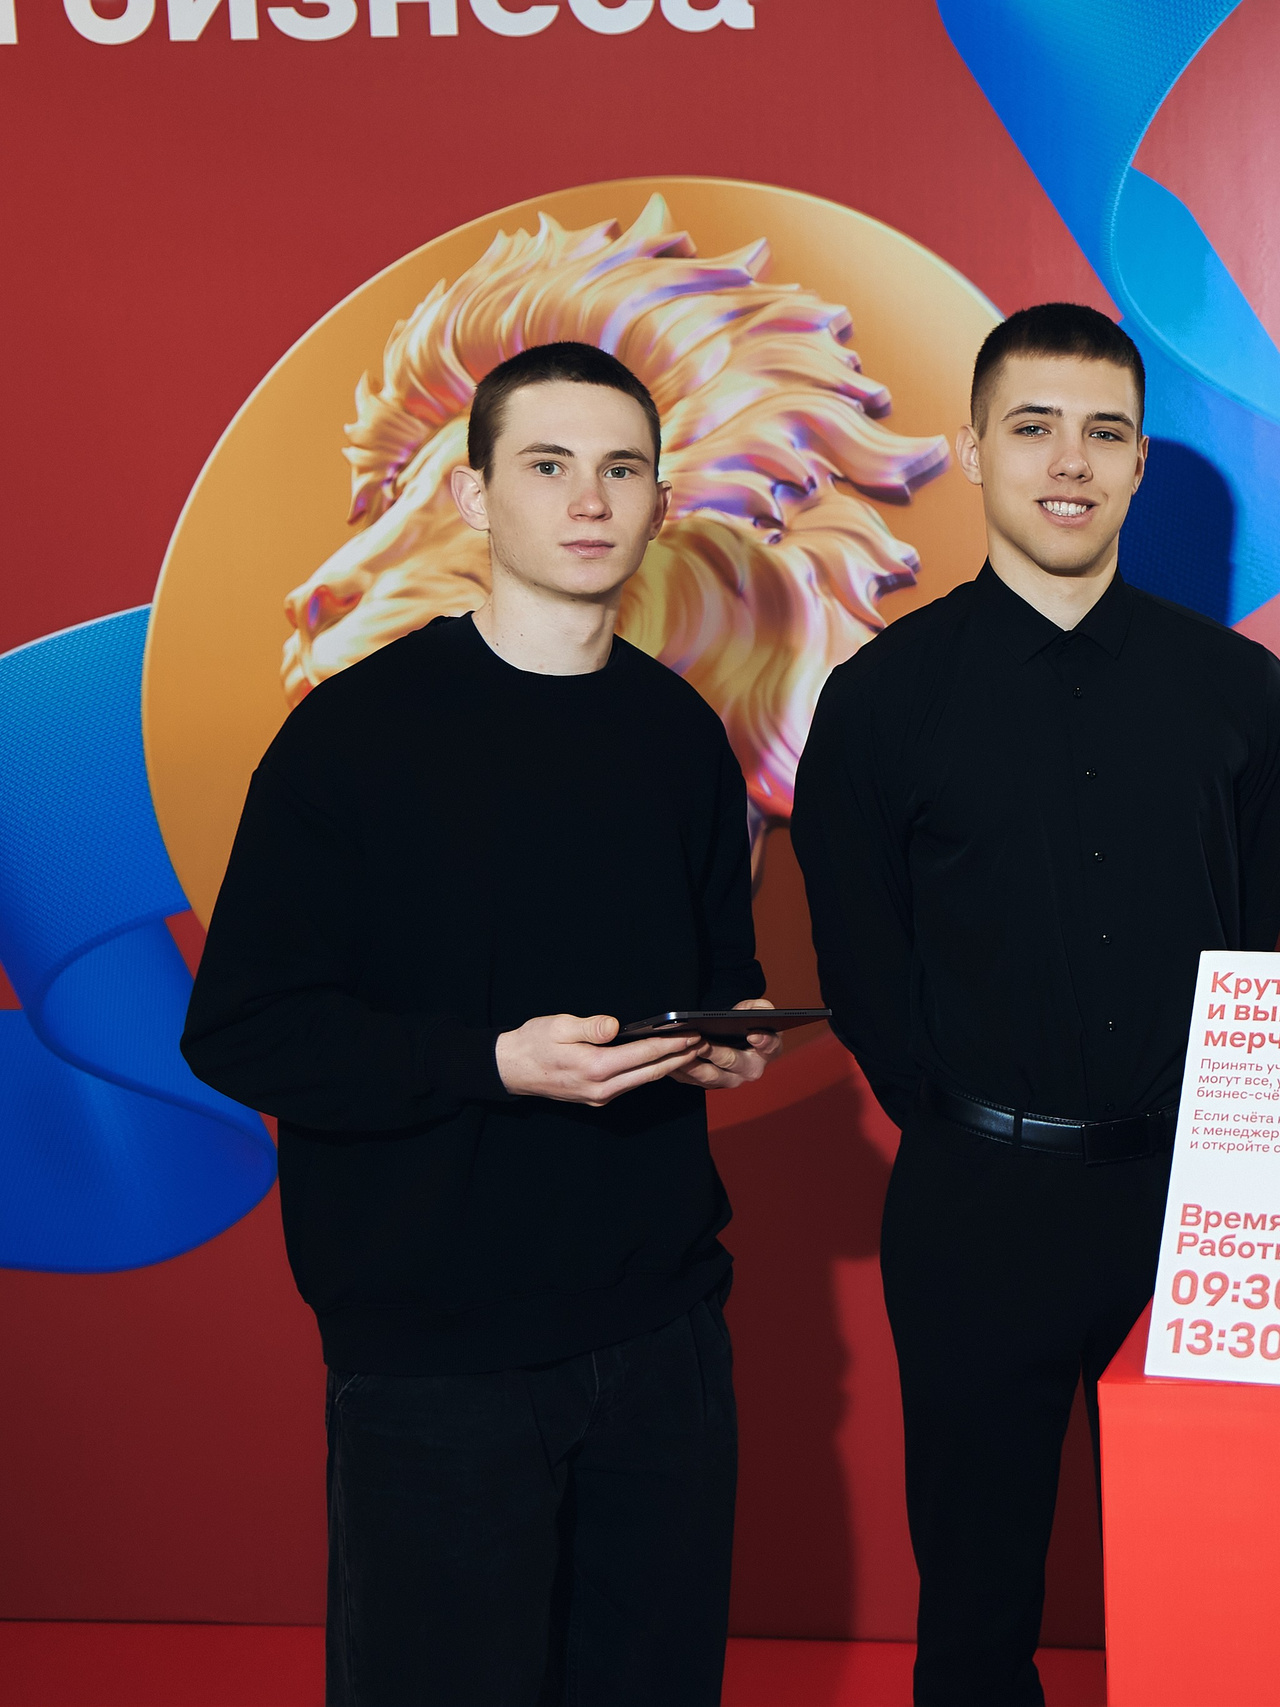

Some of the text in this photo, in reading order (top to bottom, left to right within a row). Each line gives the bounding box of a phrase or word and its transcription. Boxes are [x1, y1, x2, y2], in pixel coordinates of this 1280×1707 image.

[1207, 1003, 1227, 1021] и
[1200, 1057, 1264, 1073] Принять
[1198, 1074, 1242, 1088] могут
[1244, 1076, 1273, 1089] все,
[1193, 1108, 1230, 1122] Если
[1232, 1111, 1274, 1124] счёта
[1191, 1126, 1201, 1135] к
[1189, 1140, 1199, 1150] и
[1201, 1139, 1271, 1154] откройте
